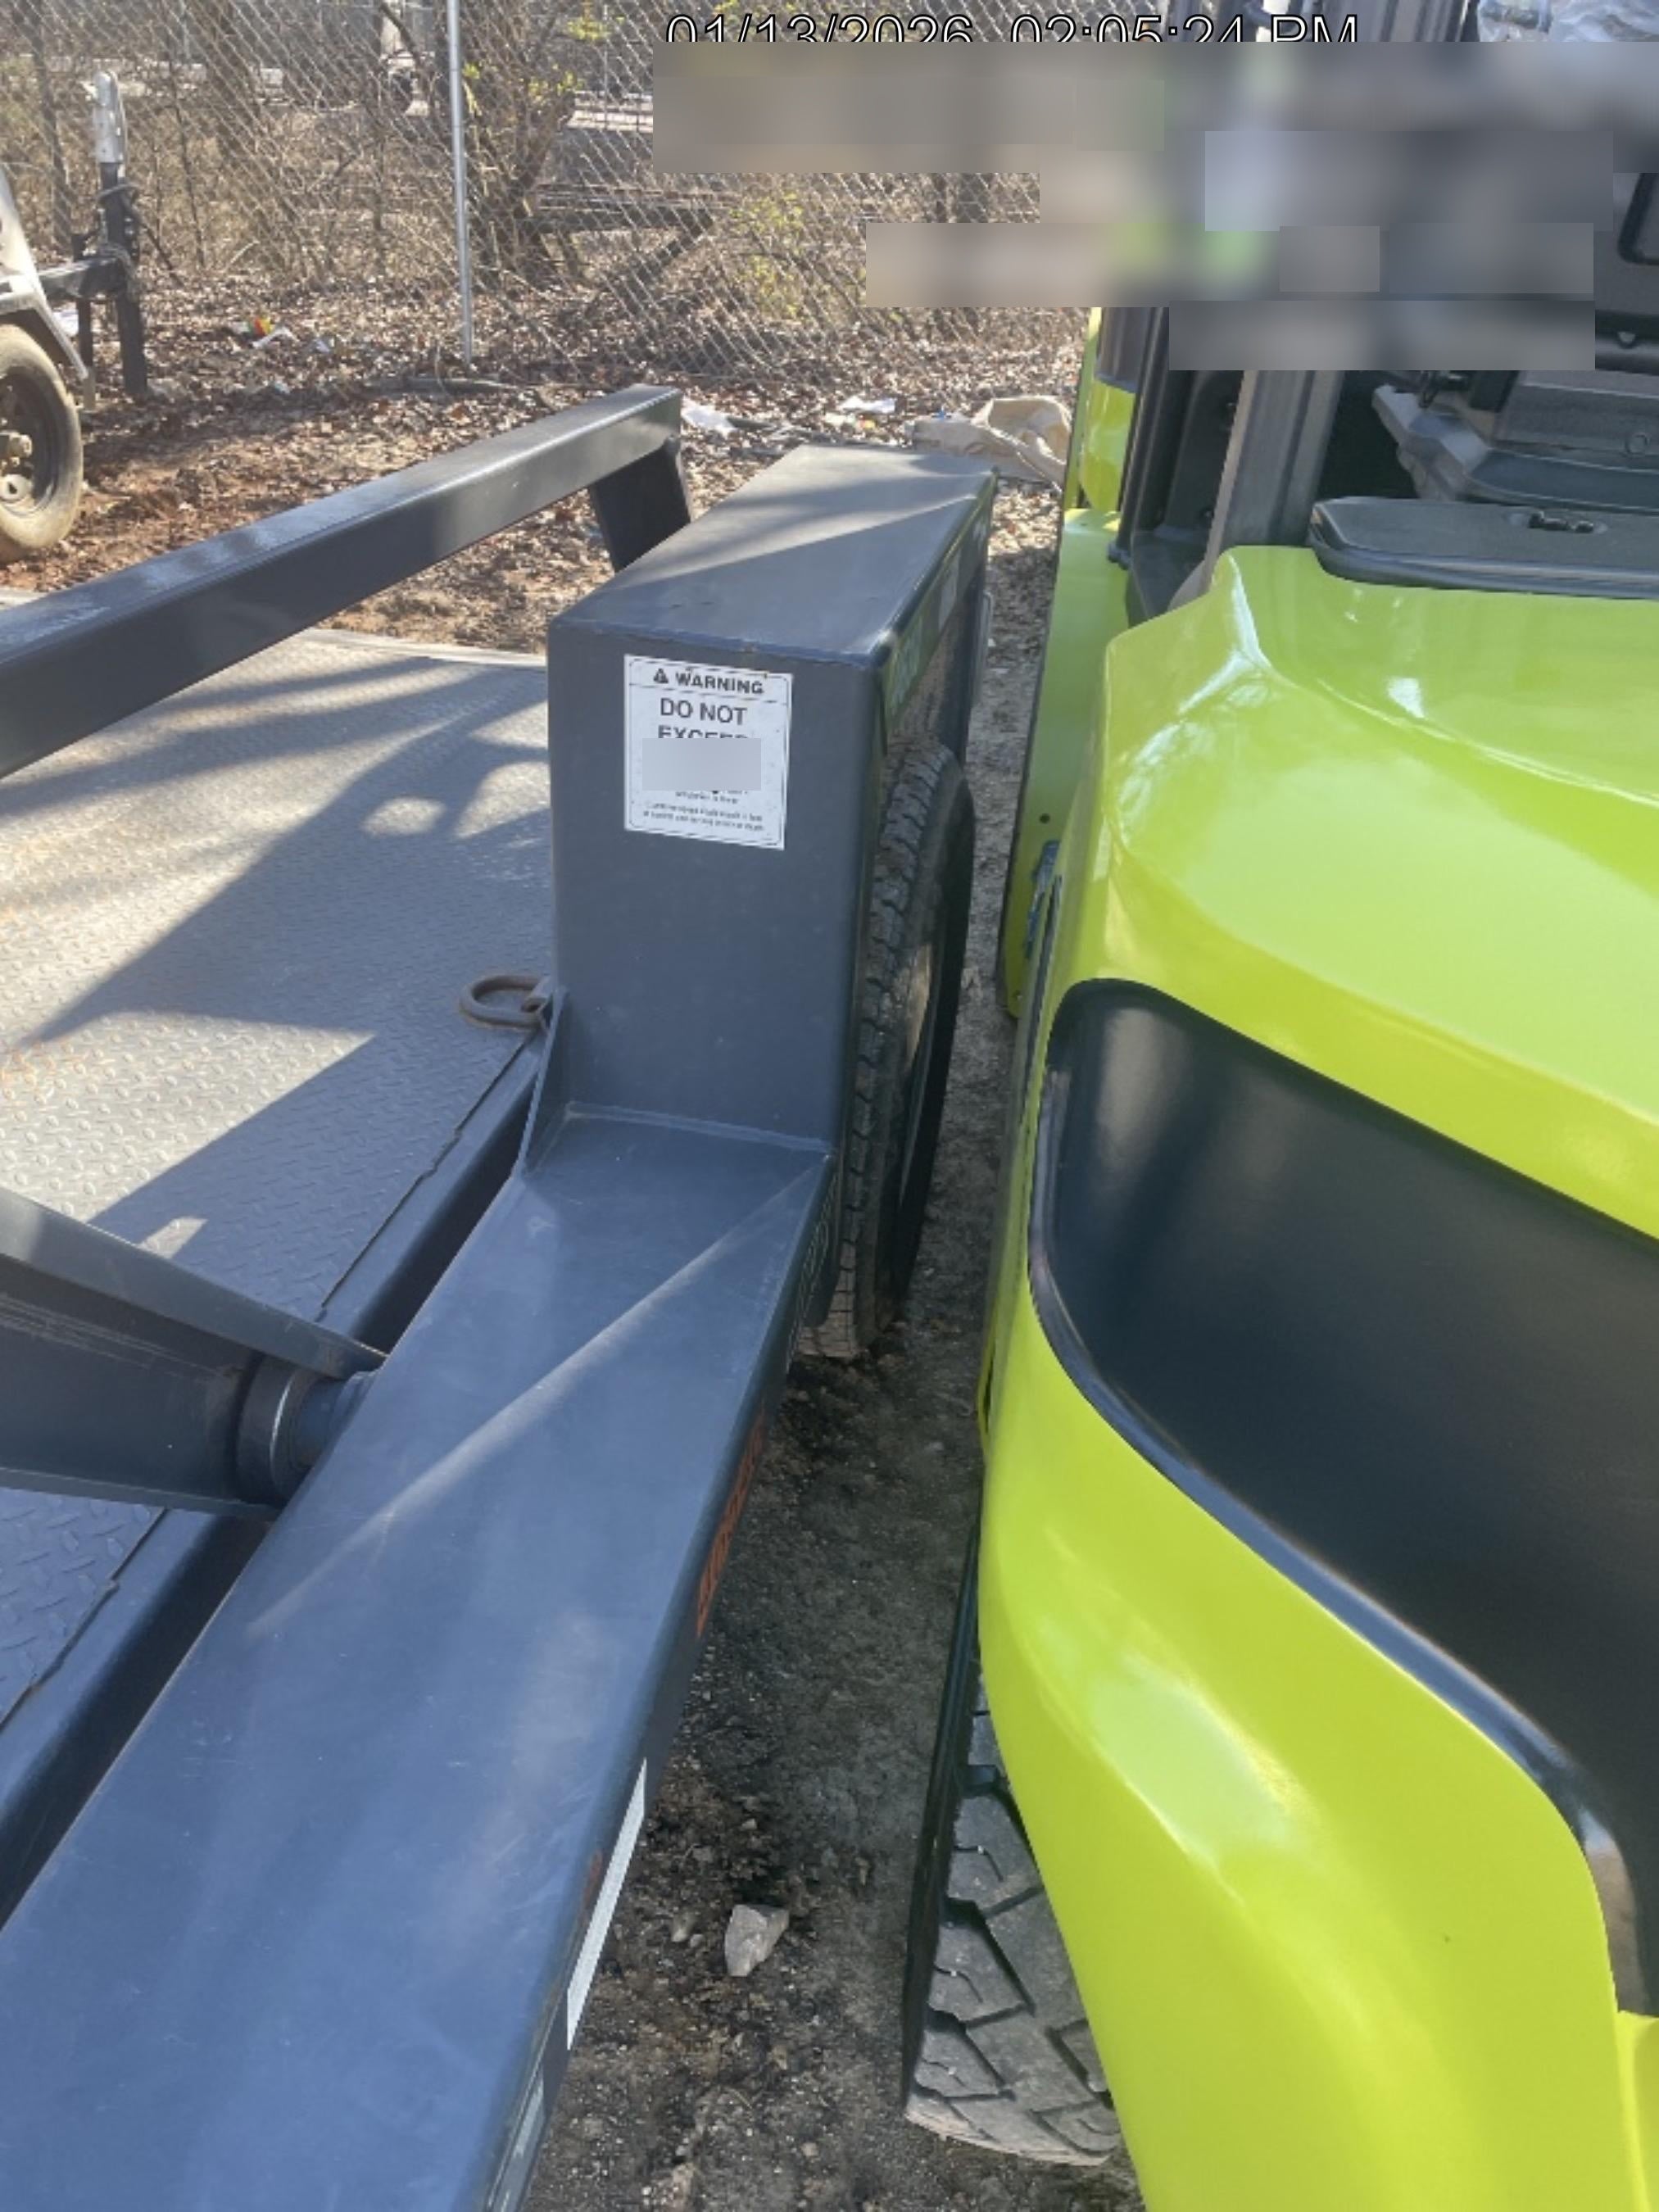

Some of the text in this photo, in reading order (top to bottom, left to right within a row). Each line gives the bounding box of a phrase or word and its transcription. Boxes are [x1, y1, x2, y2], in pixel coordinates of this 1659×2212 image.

[675, 672, 764, 694] WARNING
[660, 698, 747, 725] DO NOT
